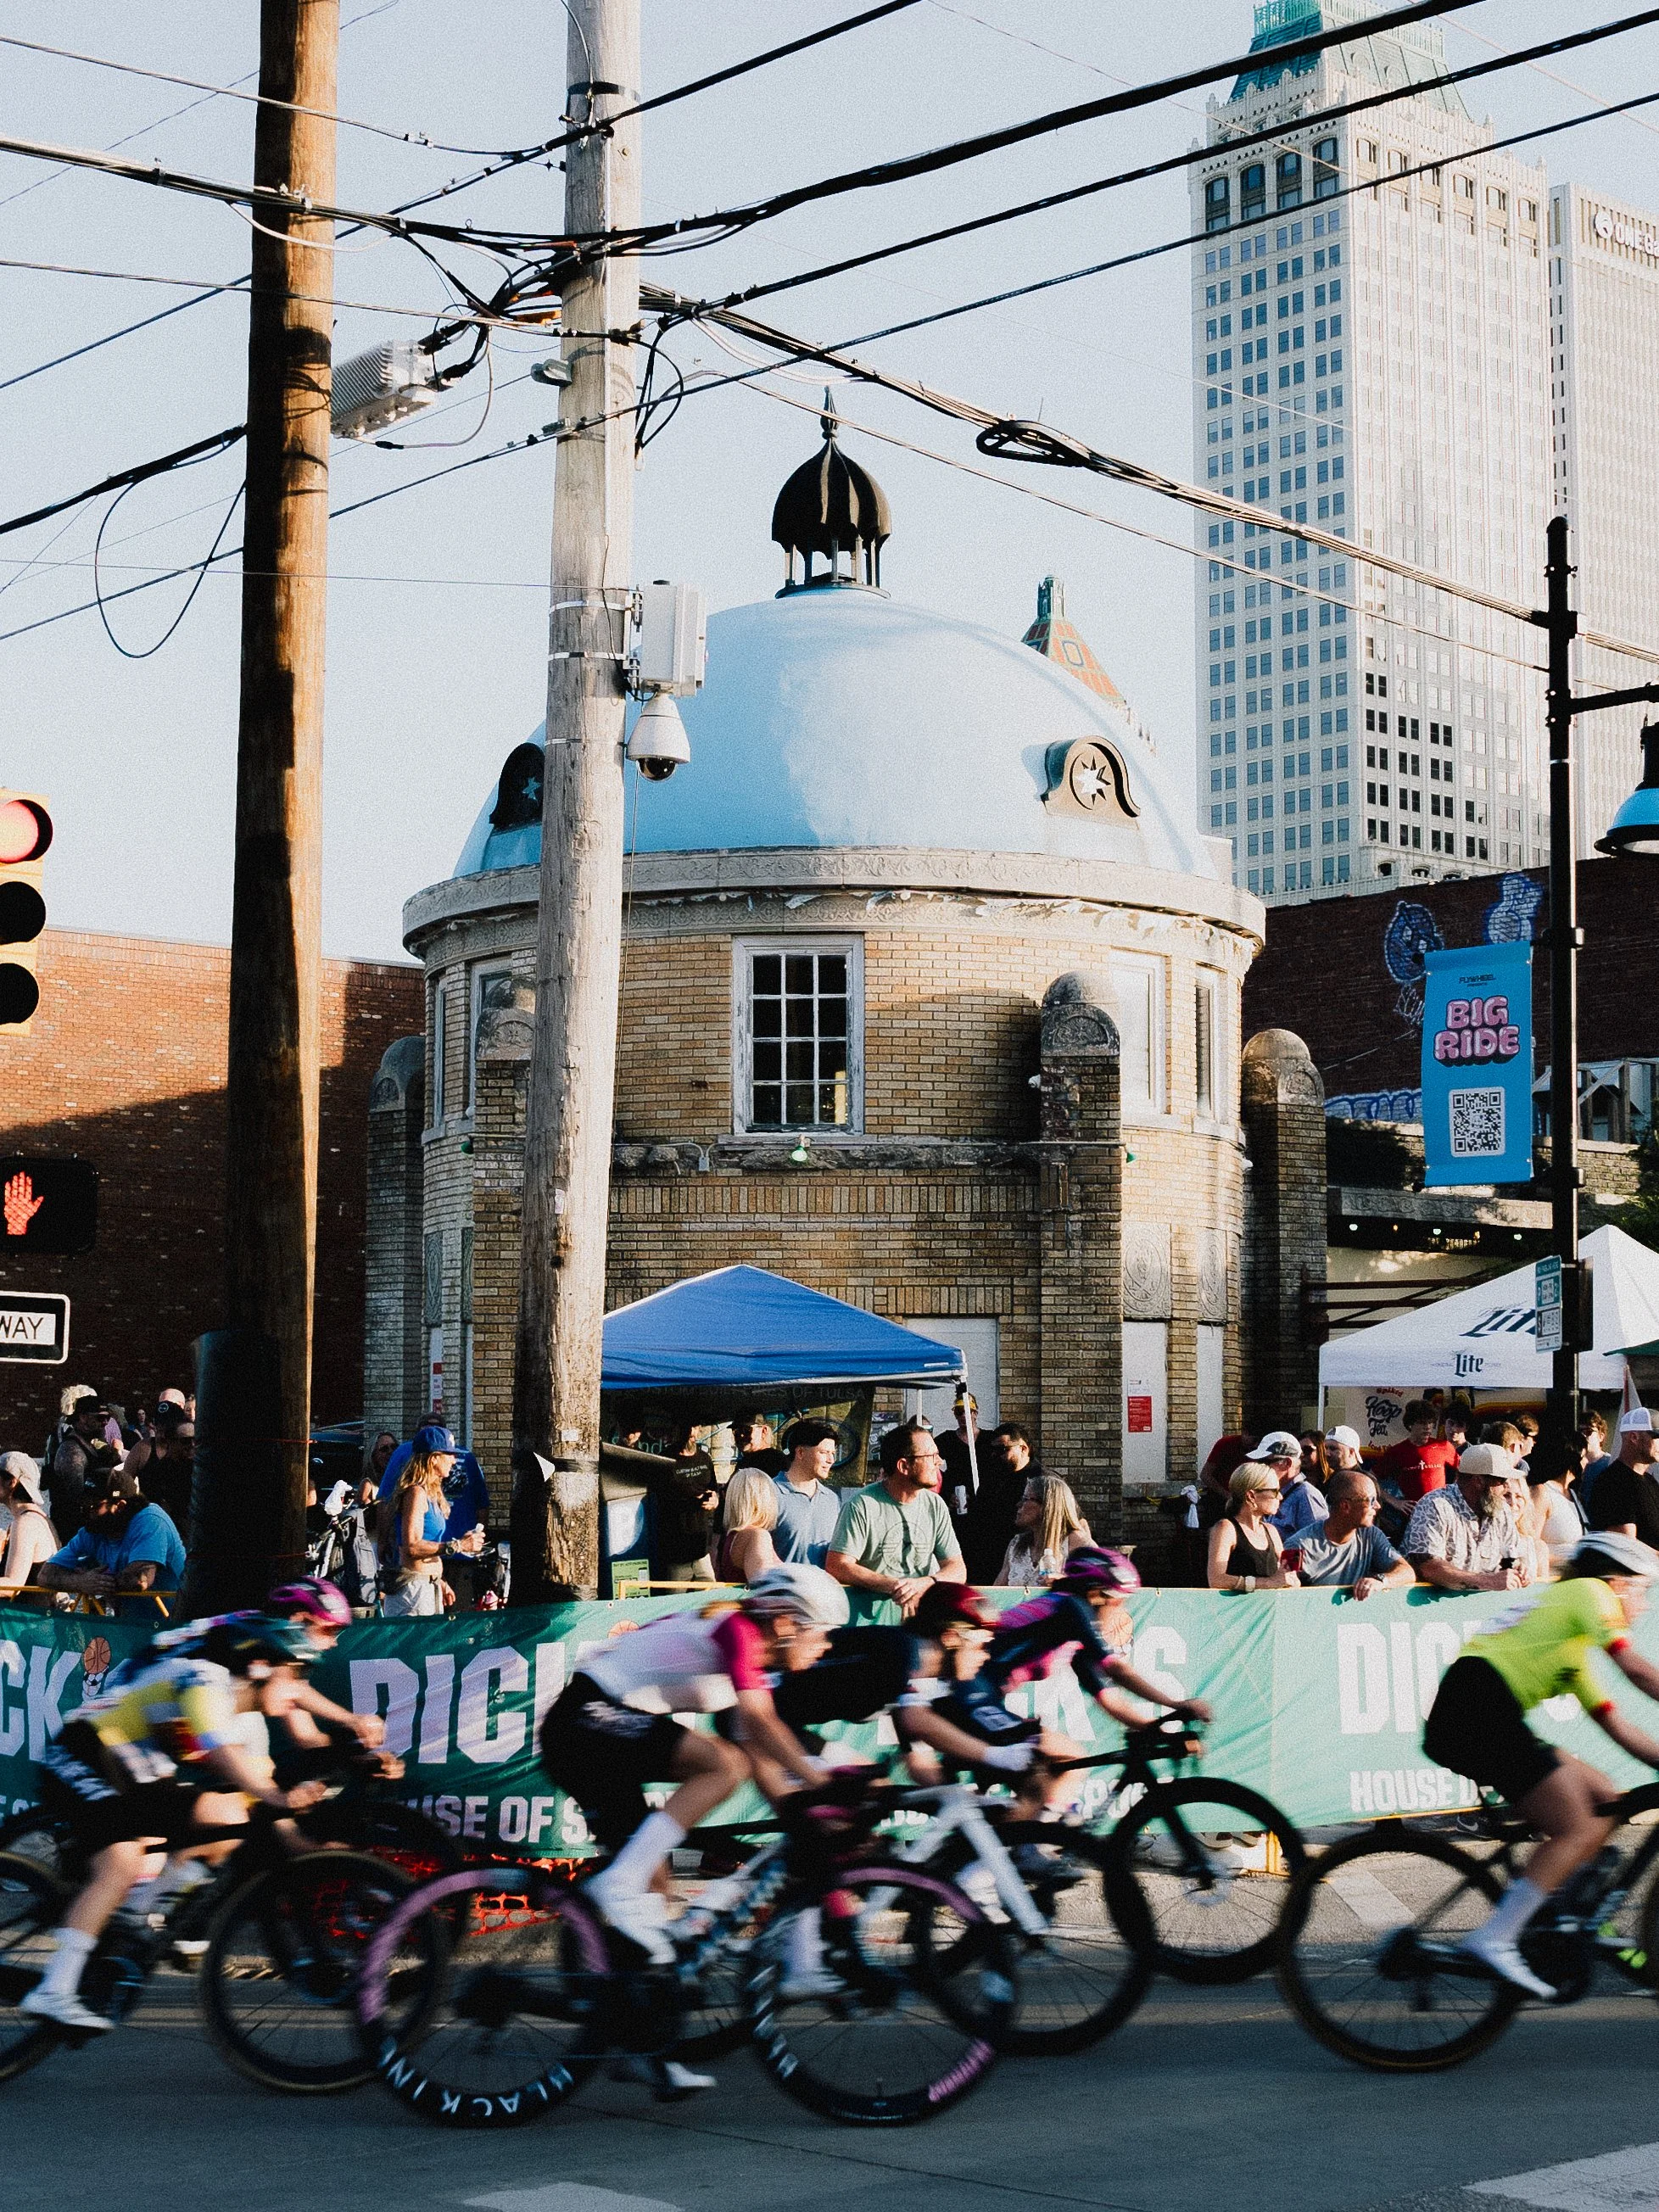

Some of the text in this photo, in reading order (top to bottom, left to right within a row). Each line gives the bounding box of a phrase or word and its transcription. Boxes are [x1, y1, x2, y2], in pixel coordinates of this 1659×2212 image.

[1446, 995, 1509, 1030] BIG
[1433, 1025, 1521, 1065] RIDE
[0, 1315, 44, 1340] WAY
[1455, 1353, 1484, 1378] Lite
[818, 1386, 866, 1399] TULSA
[1350, 1767, 1453, 1813] HOUSE
[498, 1796, 555, 1843] OF
